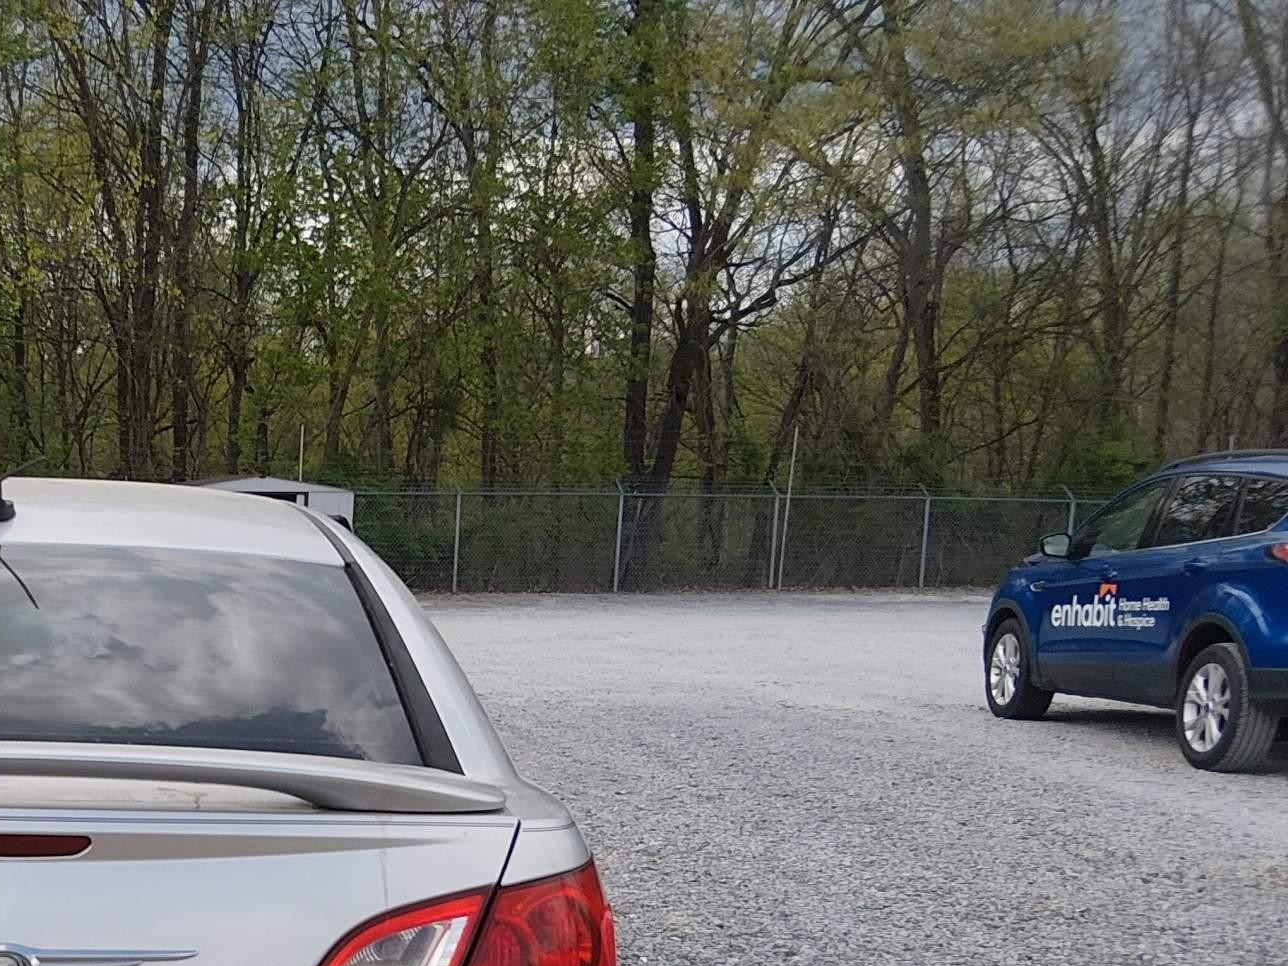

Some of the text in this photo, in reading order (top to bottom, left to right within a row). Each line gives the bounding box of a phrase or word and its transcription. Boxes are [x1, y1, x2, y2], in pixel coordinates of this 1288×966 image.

[1051, 594, 1117, 627] enhabit
[1119, 597, 1170, 611] Home Health
[1124, 614, 1156, 630] Hospice
